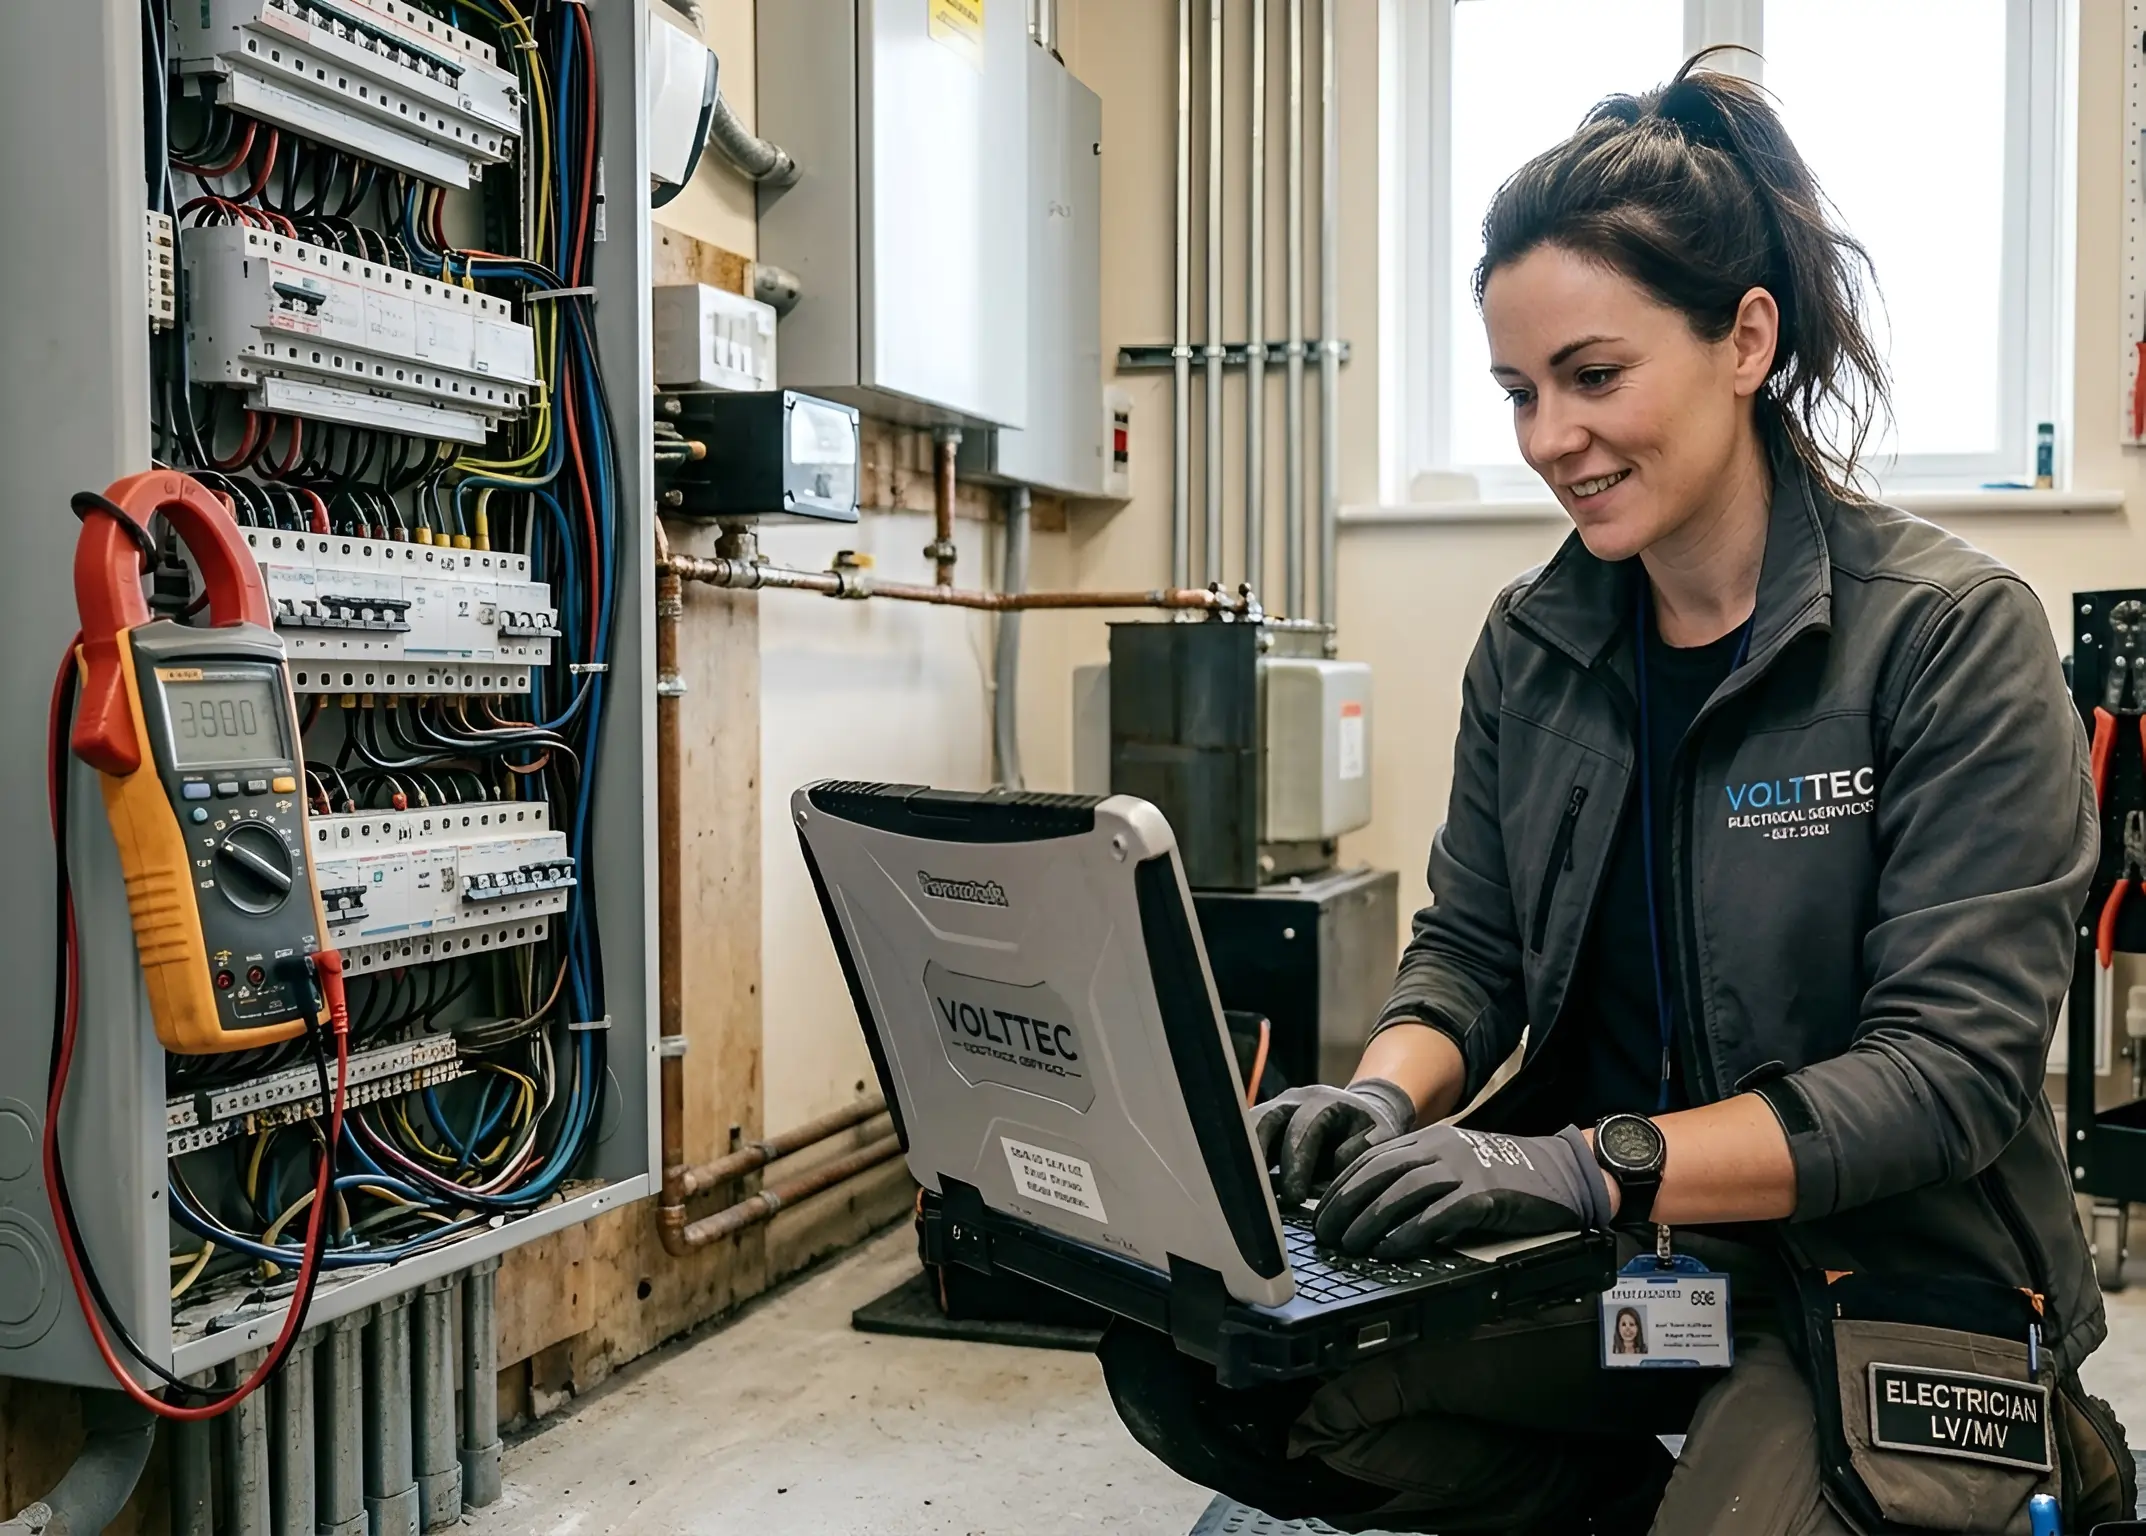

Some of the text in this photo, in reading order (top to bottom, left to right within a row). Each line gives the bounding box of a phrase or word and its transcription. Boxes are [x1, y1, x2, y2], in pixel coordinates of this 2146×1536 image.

[1725, 766, 1875, 811] VOLTTEC
[936, 996, 1078, 1062] VOLTTEC
[1885, 1379, 2038, 1424] ELECTRICIAN
[1930, 1415, 2009, 1449] LV/MV
